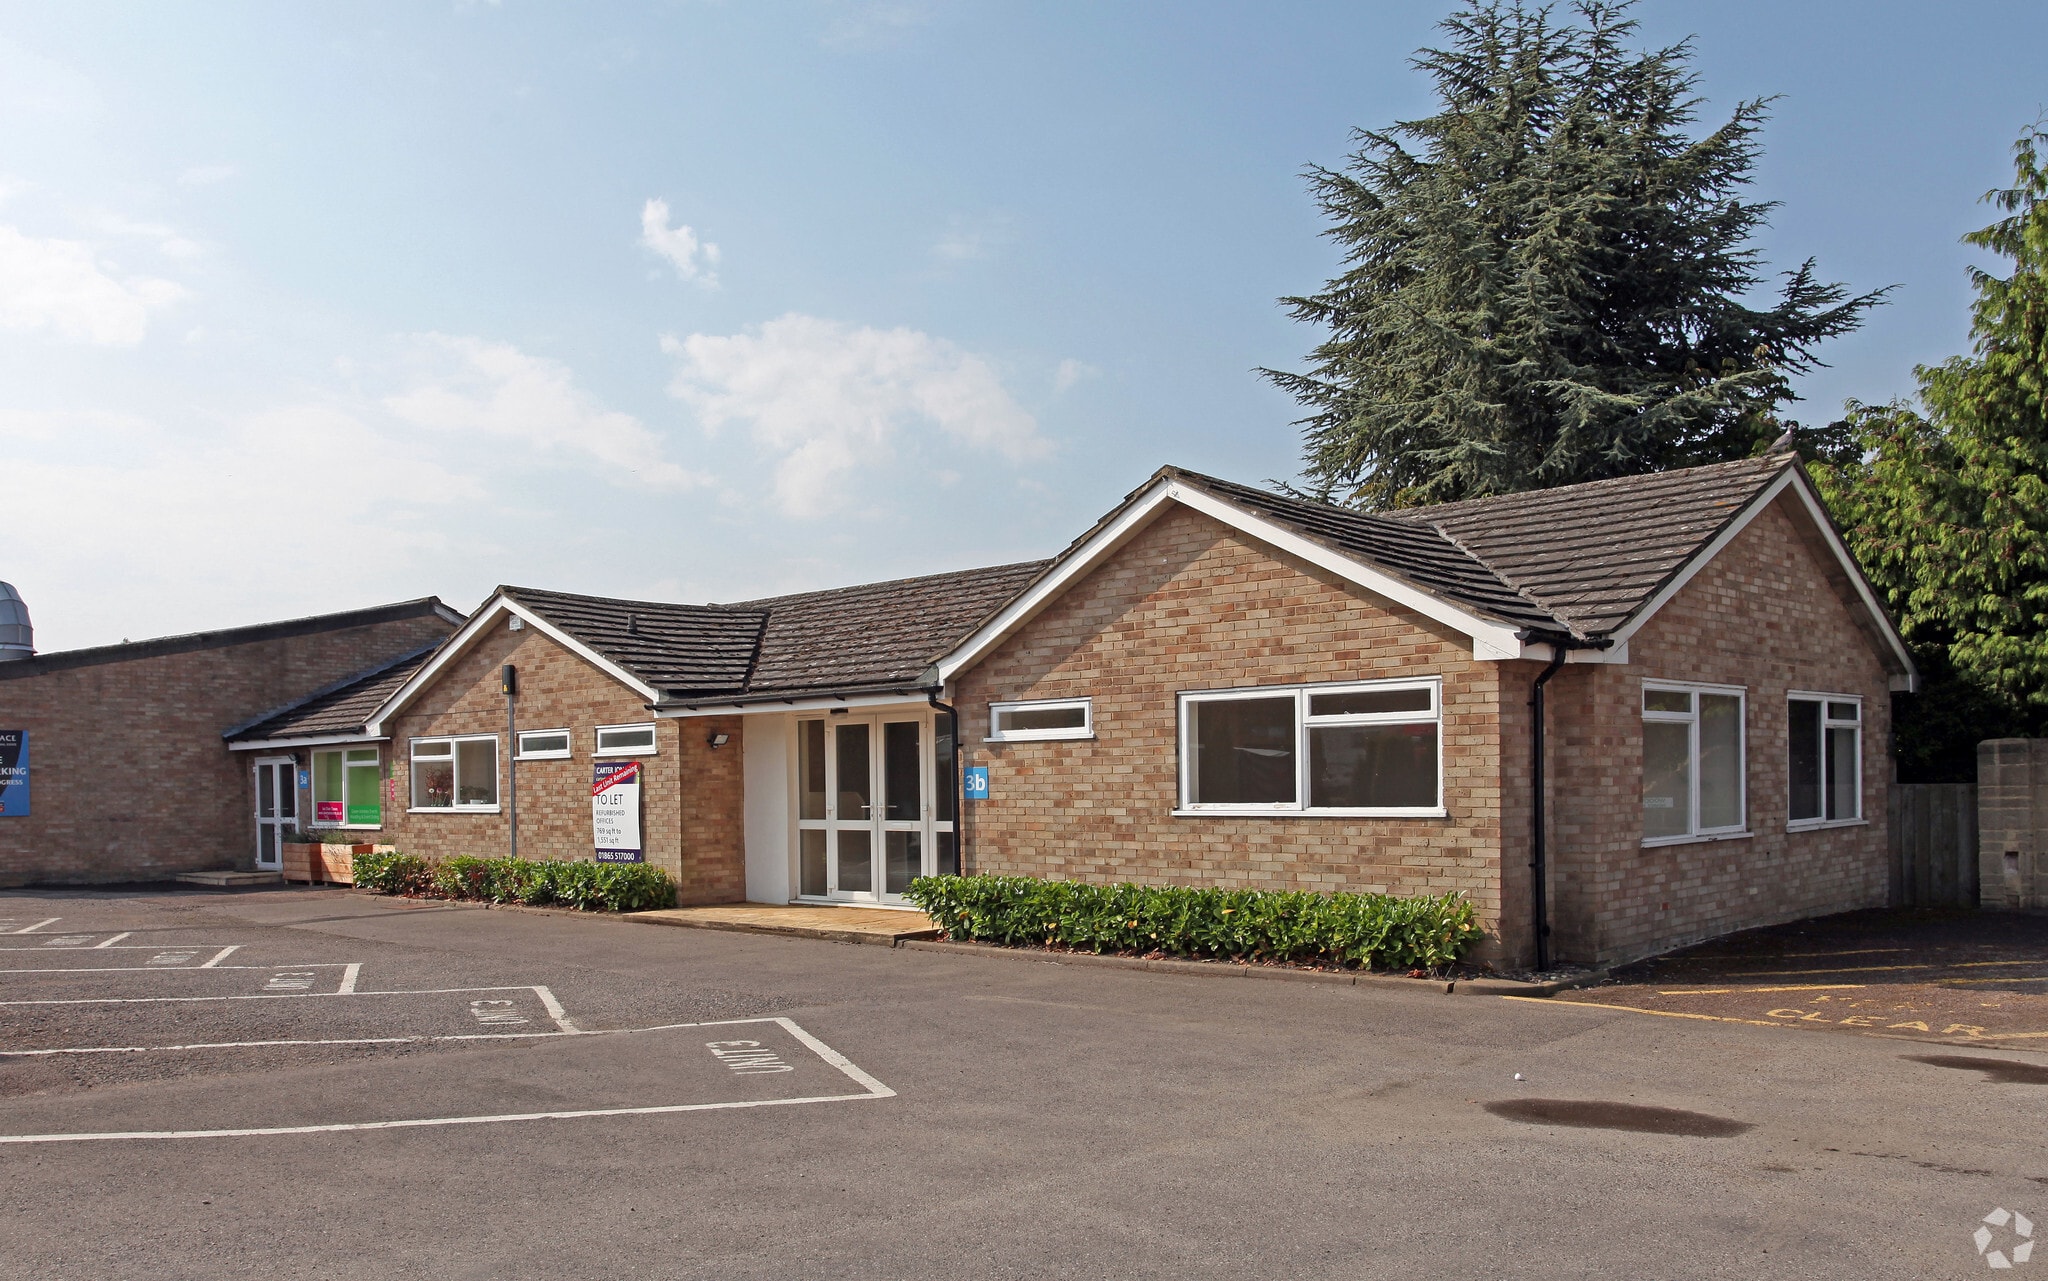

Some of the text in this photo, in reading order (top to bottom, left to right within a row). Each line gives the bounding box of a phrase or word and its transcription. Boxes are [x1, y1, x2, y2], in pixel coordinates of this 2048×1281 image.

[0, 767, 27, 776] KING
[596, 766, 614, 774] CARTER
[300, 775, 308, 785] 3a
[593, 783, 603, 793] Last
[602, 777, 614, 788] Unit
[613, 764, 638, 782] Remaining
[966, 773, 986, 791] 3b
[597, 793, 623, 805] TO LET
[596, 809, 626, 817] REFURBISHED
[596, 817, 614, 825] OFFICES
[598, 851, 635, 860] 01865 517000
[1765, 1008, 1989, 1038] CLEAR
[705, 1040, 794, 1075] UNIT 3
